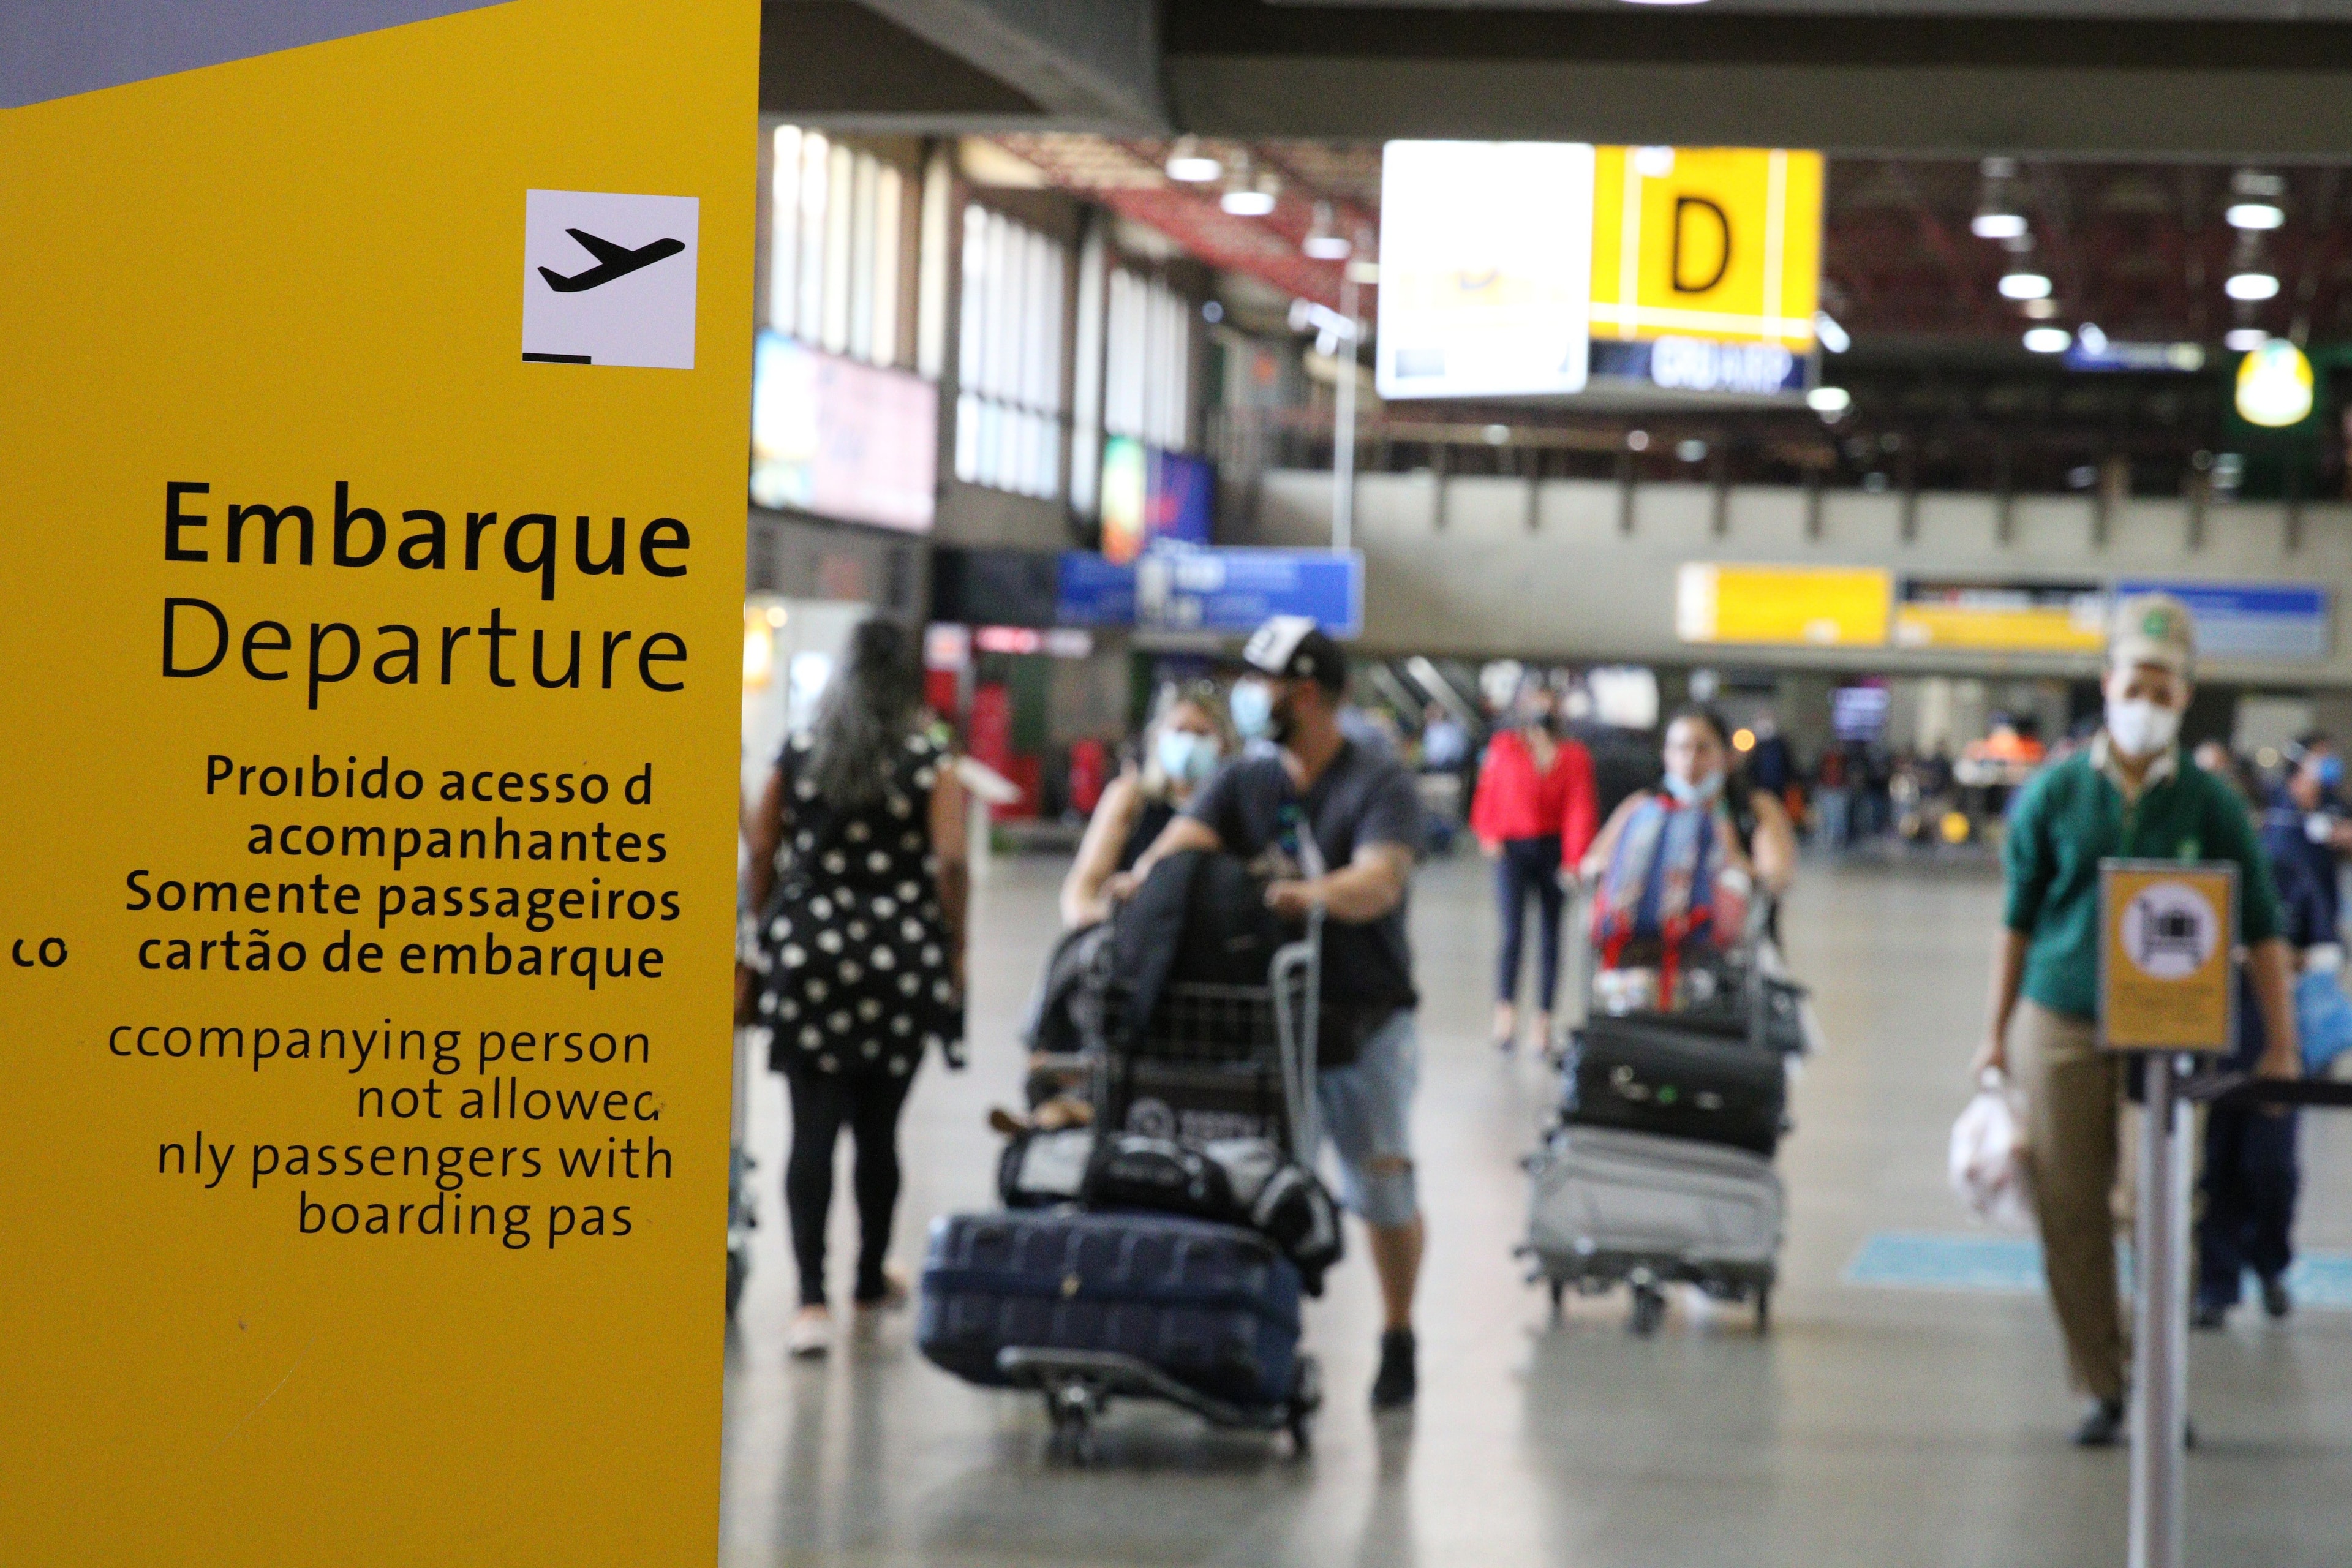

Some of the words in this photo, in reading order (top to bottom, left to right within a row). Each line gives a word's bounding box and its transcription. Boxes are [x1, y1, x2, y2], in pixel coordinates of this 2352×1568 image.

[1672, 196, 1730, 293] D
[165, 480, 690, 601] Embarque
[162, 597, 688, 710] Departure
[440, 770, 608, 804] acesso
[247, 816, 666, 872] acompanhantes
[126, 869, 360, 915] Somente
[379, 876, 680, 932] passageiros
[138, 928, 306, 973] cartão
[323, 929, 383, 974] de
[400, 931, 663, 990] embarque
[109, 1017, 461, 1076] ccompanying
[479, 1031, 649, 1075] person
[358, 1079, 442, 1120] not
[159, 1131, 235, 1189] nly
[252, 1144, 541, 1191] passengers
[559, 1134, 672, 1178] with
[300, 1190, 531, 1250] boarding
[549, 1205, 631, 1250] pas
